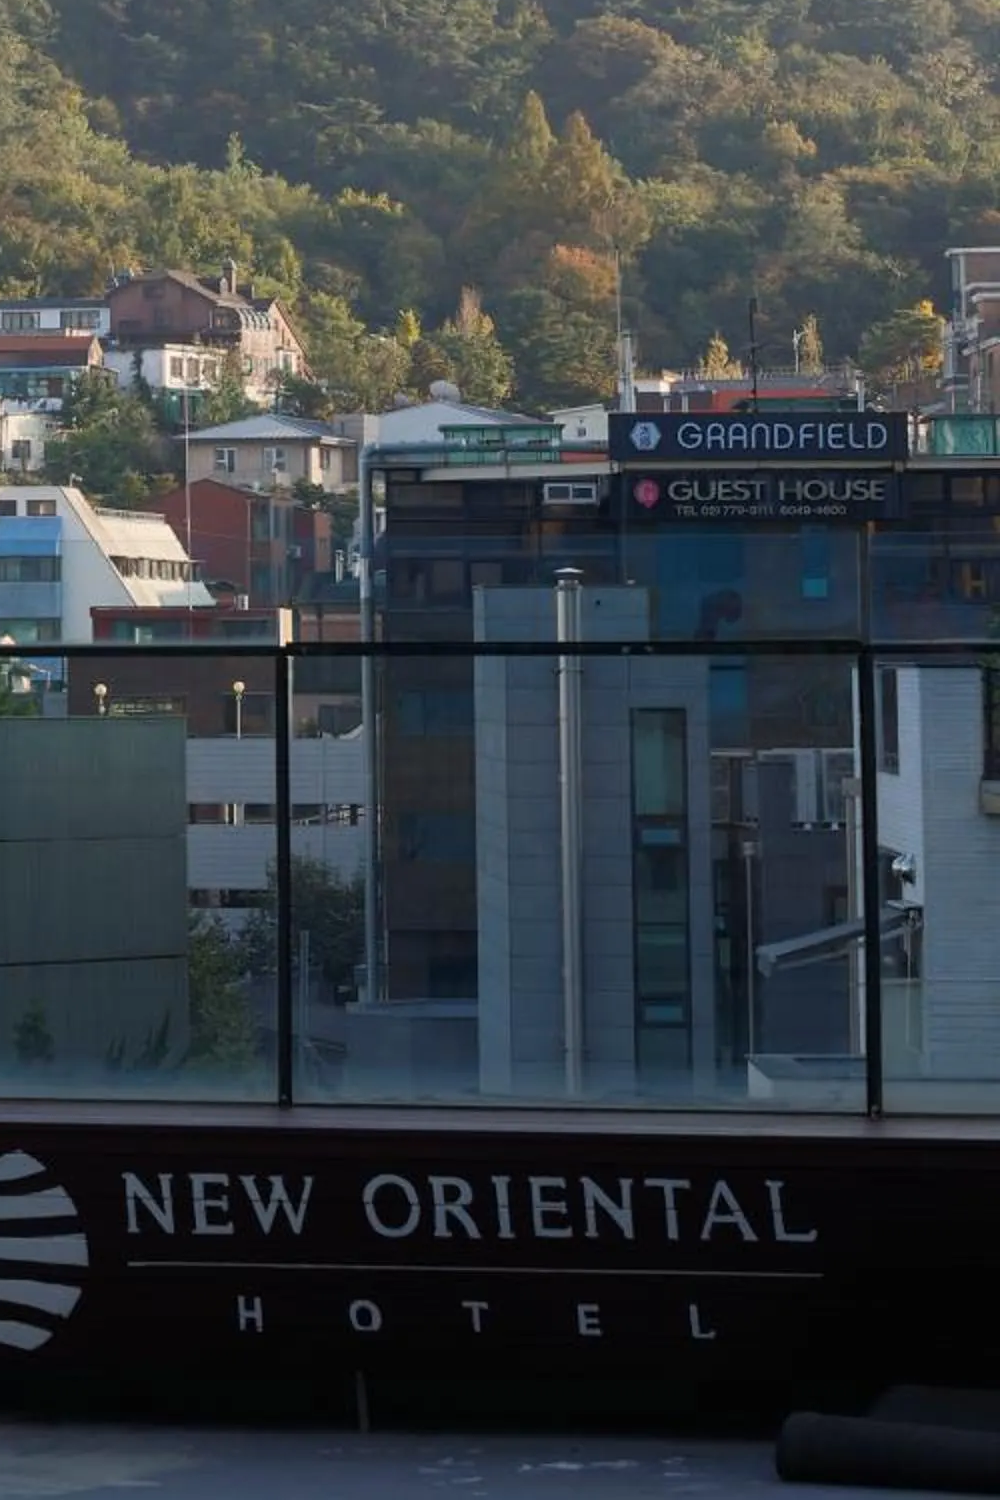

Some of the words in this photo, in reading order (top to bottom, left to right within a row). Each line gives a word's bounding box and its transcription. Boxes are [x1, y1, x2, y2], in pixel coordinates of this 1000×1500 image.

[677, 422, 887, 450] GRANDFIELD
[667, 479, 766, 502] GUEST
[779, 479, 886, 501] HOUSE
[674, 504, 698, 516] TEL
[121, 1170, 315, 1237] NEW
[362, 1172, 818, 1244] ORIENTAL
[237, 1294, 716, 1340] HOTEL
